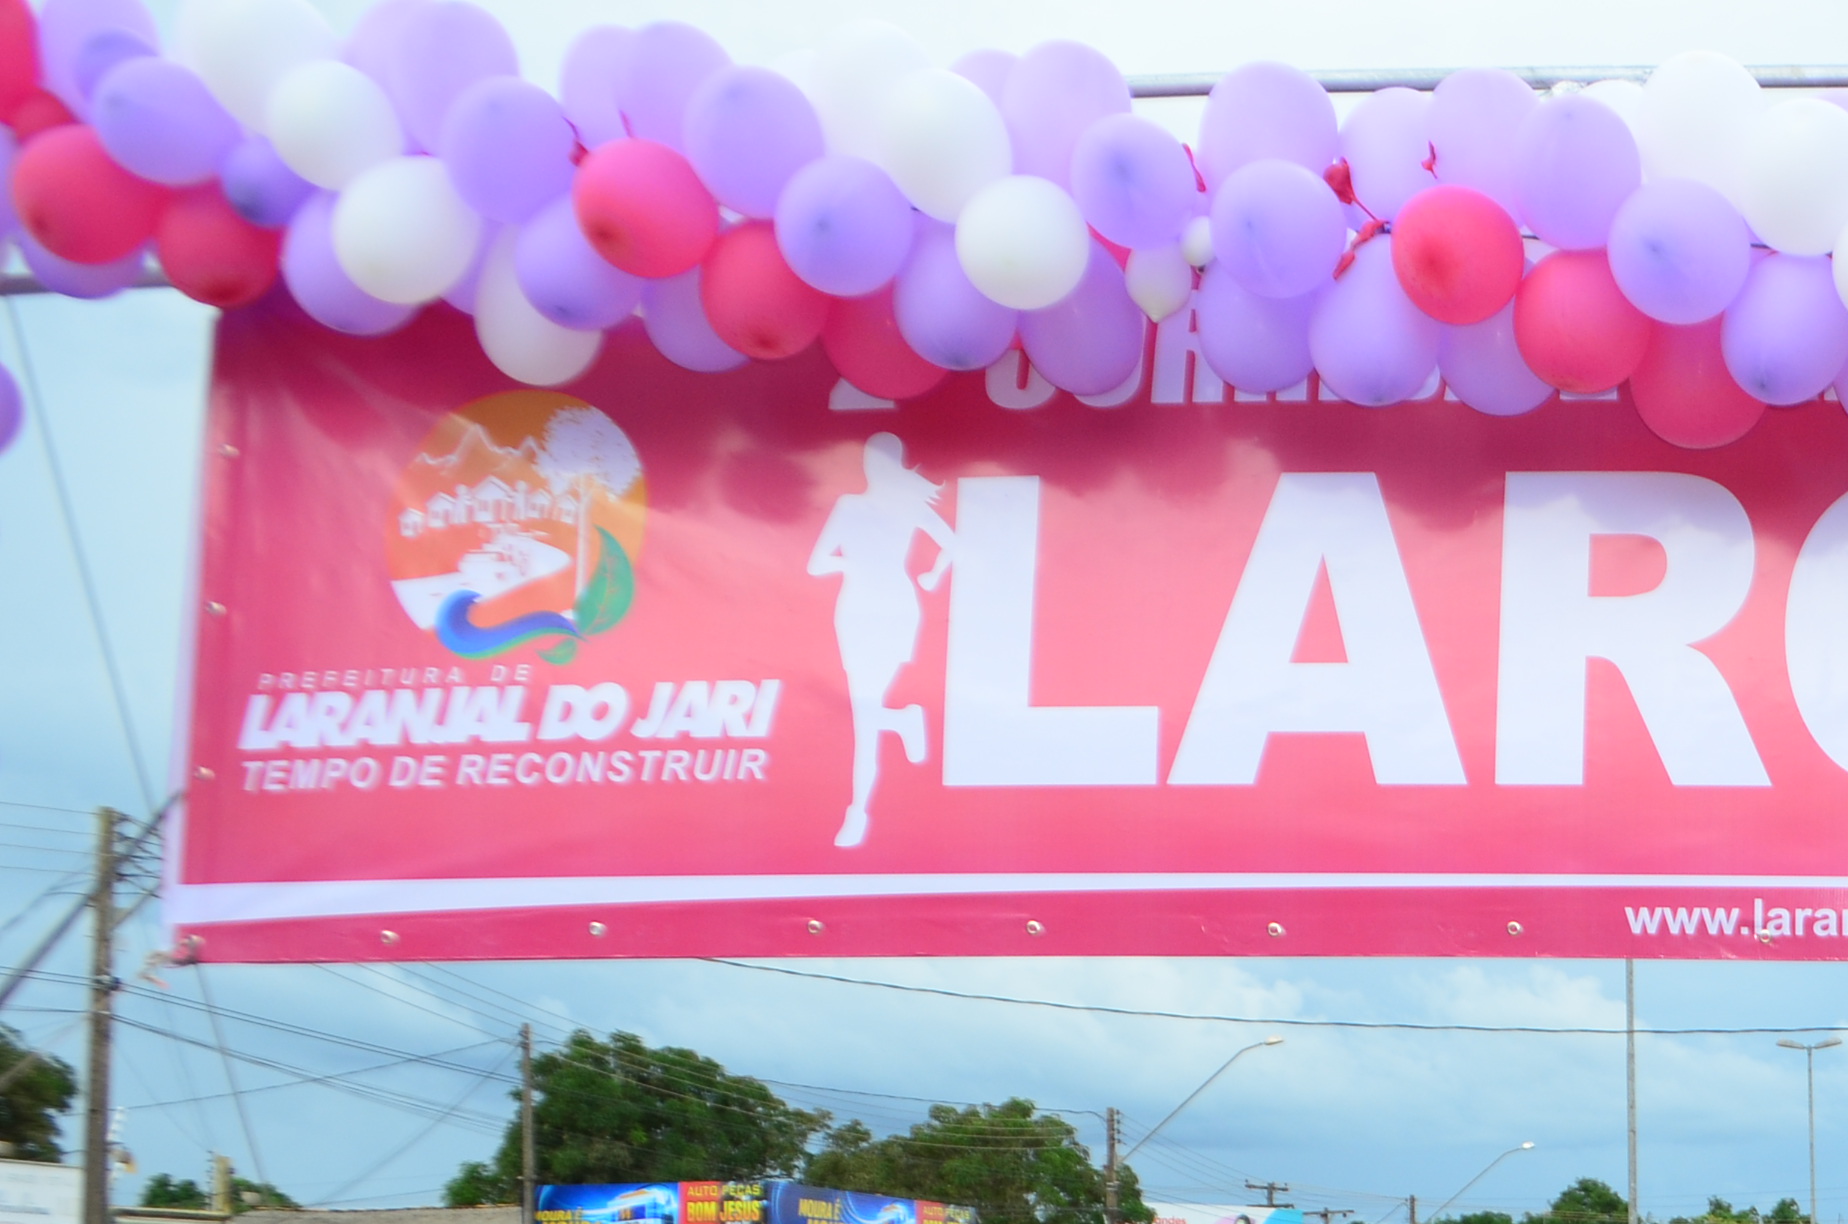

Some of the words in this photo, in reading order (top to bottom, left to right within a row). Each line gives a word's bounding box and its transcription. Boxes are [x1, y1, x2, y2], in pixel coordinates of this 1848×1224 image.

[258, 666, 464, 691] PREFEITURA
[491, 664, 533, 683] DE
[239, 685, 535, 750] LARANJAL
[538, 682, 628, 743] DO
[631, 678, 782, 740] JARI
[241, 758, 377, 792] TEMPO
[389, 755, 444, 787] DE
[455, 748, 768, 787] RECONSTRUIR
[687, 1186, 718, 1196] AUTO
[687, 1201, 716, 1222] BOM
[719, 1200, 761, 1222] JESUS
